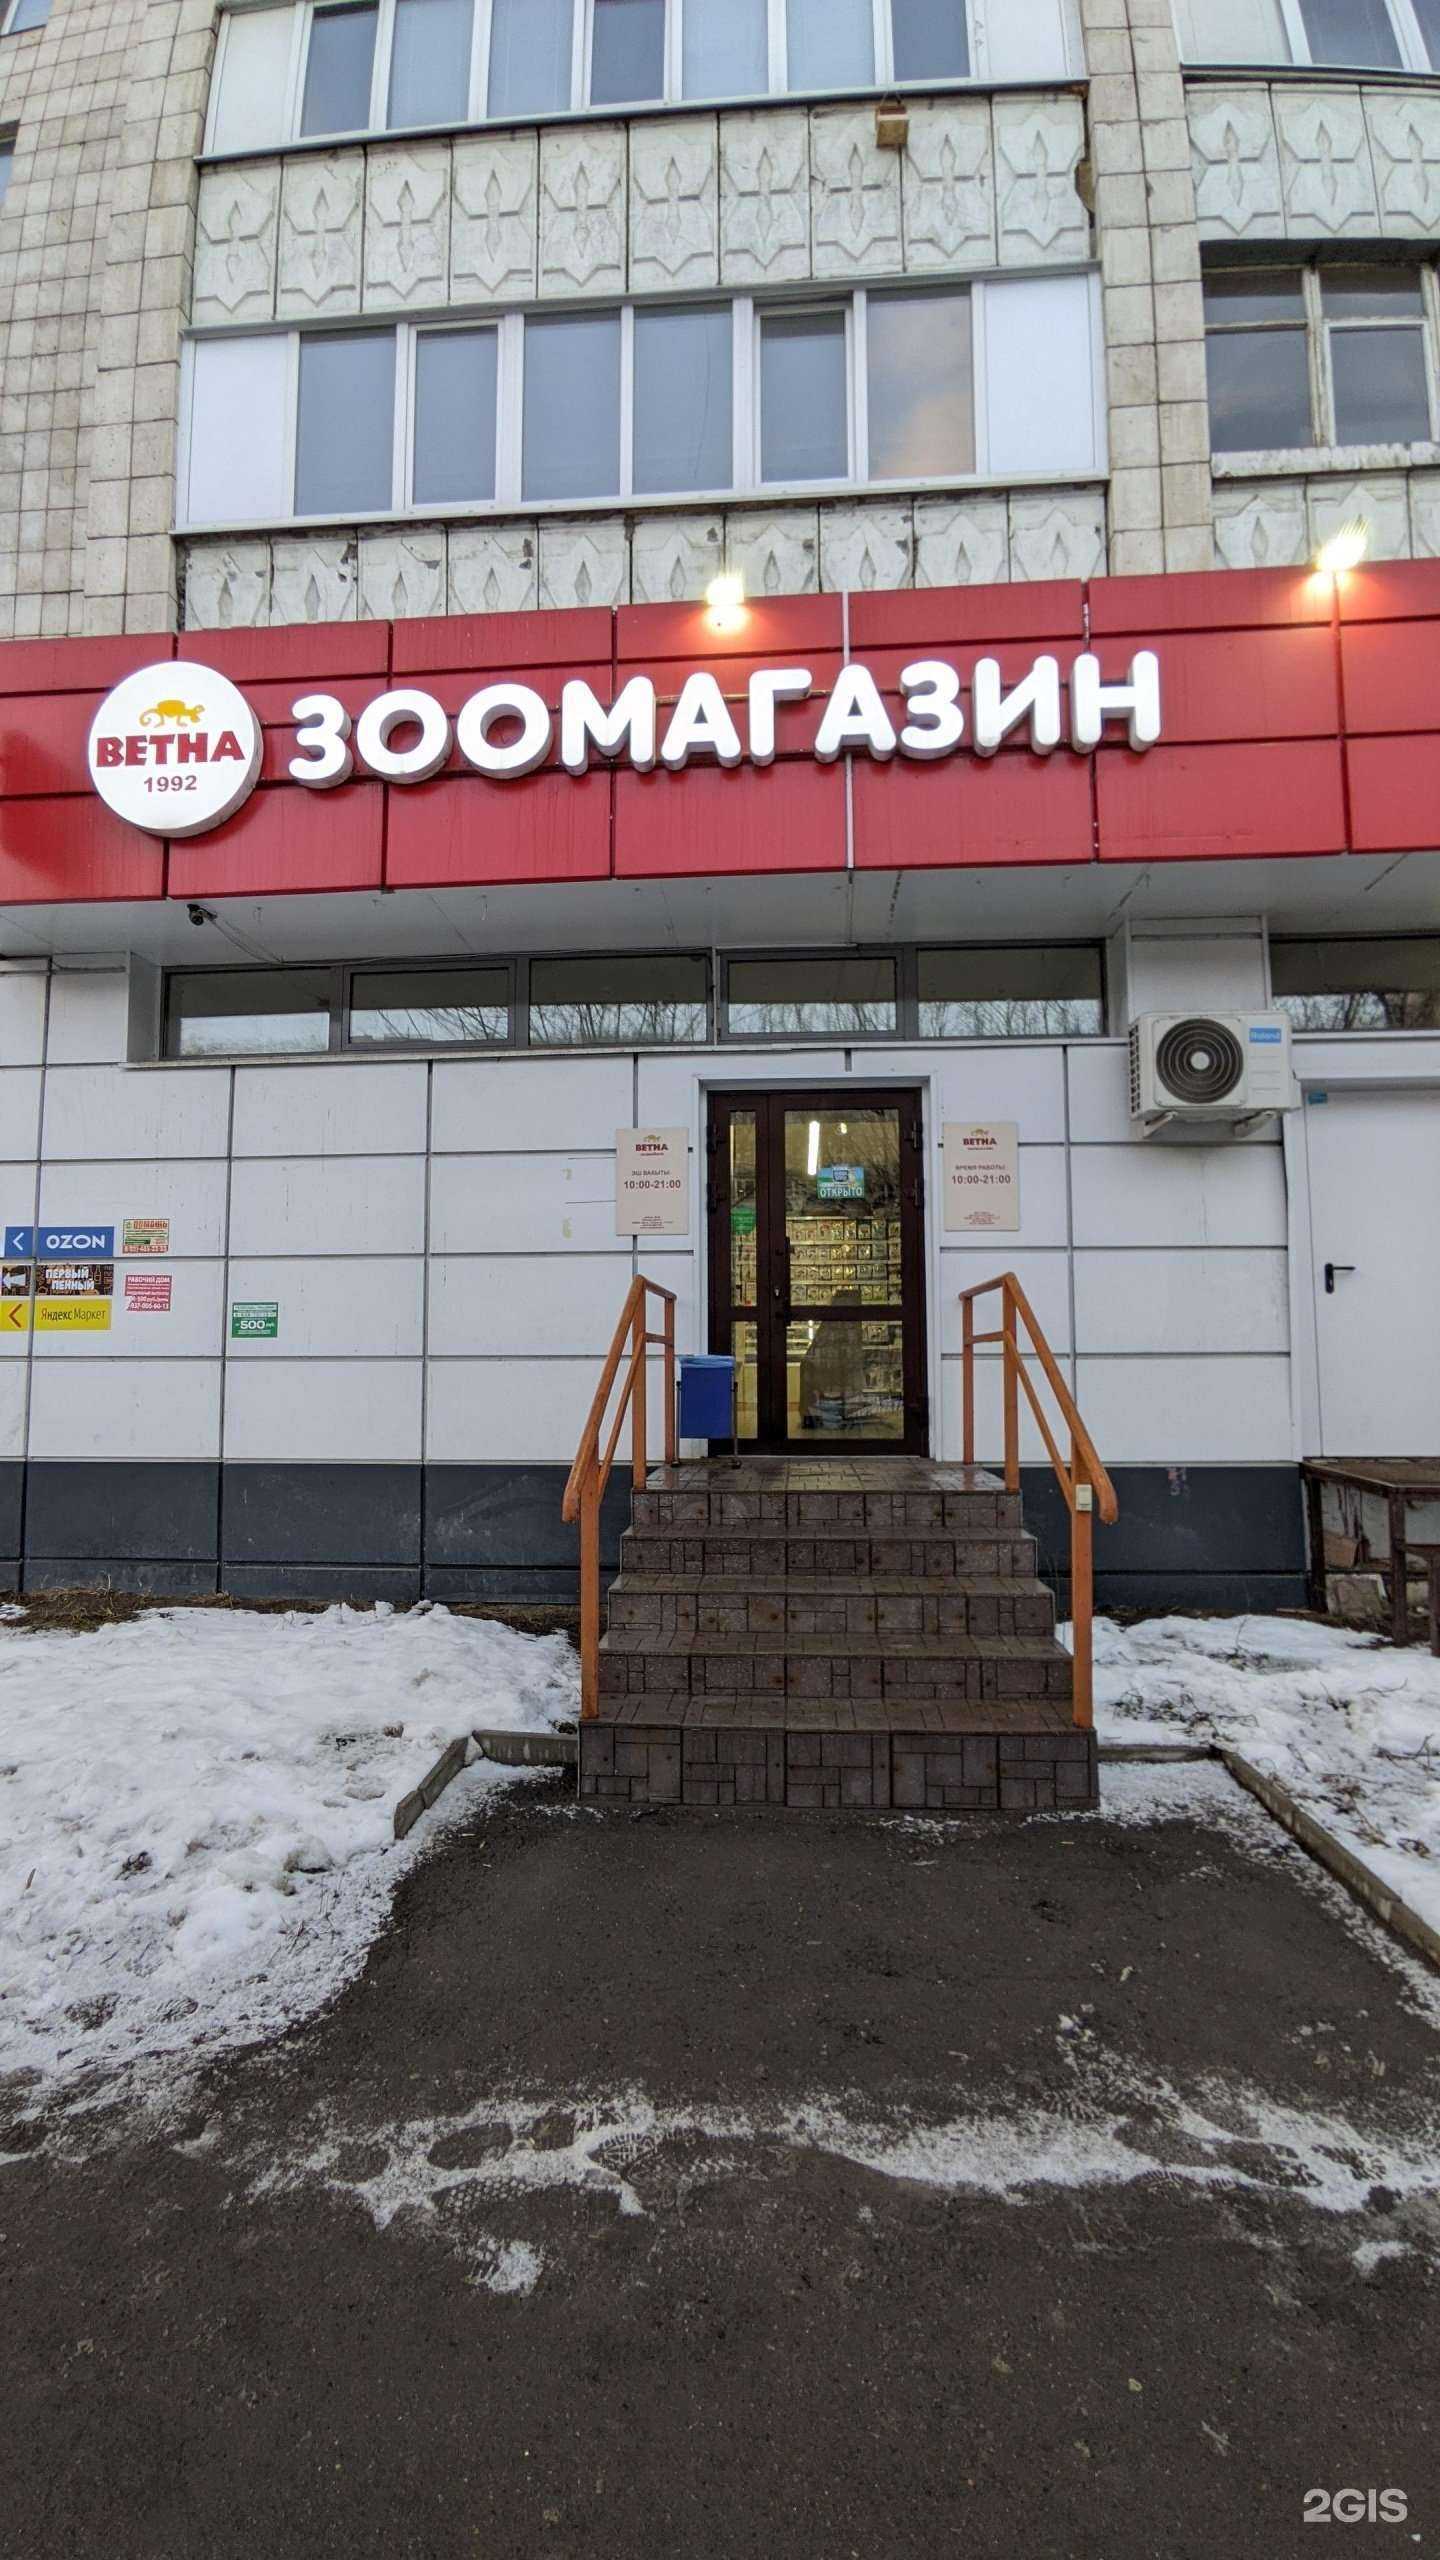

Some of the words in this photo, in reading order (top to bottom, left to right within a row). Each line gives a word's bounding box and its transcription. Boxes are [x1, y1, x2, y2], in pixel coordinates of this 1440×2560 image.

[287, 650, 1161, 790] ЗООМАГАЗИН
[95, 731, 245, 768] ВЕТНА
[143, 775, 198, 793] 1992
[963, 1137, 997, 1146] ВЕТНА
[635, 1143, 668, 1152] ВЕТНА
[624, 1180, 681, 1189] 10:00-21:00
[952, 1175, 1011, 1184] 10:00-21:00
[820, 1187, 863, 1198] ОТКРЫТО
[46, 1234, 105, 1249] OZON
[46, 1266, 89, 1279] ПЕРВЫЙ
[52, 1279, 95, 1290] ПЕННЫЙ
[41, 1308, 73, 1321] Яндекс
[74, 1308, 106, 1321] Маркет
[240, 1320, 265, 1329] 500
